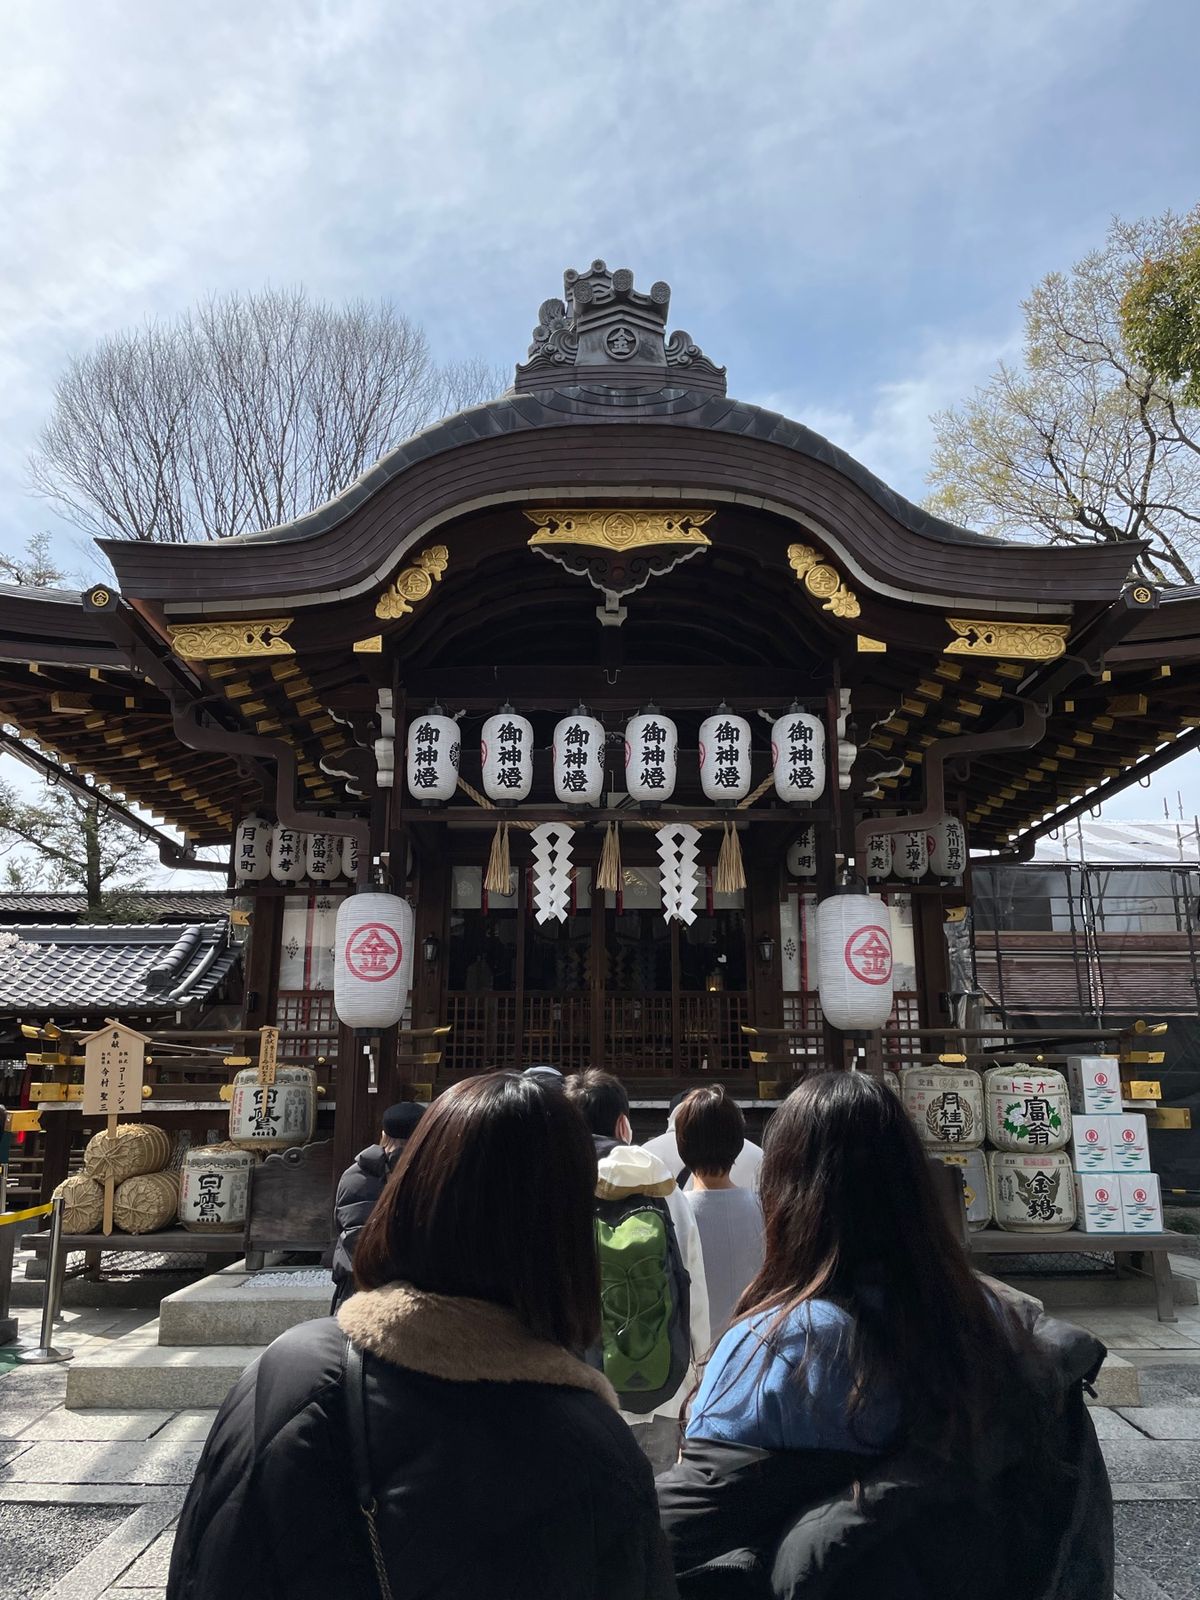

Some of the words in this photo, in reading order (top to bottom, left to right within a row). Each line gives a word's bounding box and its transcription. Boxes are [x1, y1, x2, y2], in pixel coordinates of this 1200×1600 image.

[607, 327, 635, 354] 金
[607, 514, 633, 539] 金
[413, 721, 441, 789] 御神燈
[496, 721, 524, 790] 御神燈
[562, 723, 591, 793] 御神燈
[640, 720, 667, 789] 御神燈
[713, 720, 741, 789] 御神燈
[787, 720, 816, 789] 御神燈
[240, 826, 257, 873] 月見町
[350, 928, 397, 973] 金
[852, 931, 892, 976] 金
[1011, 1082, 1056, 1093] トミオー
[939, 1091, 963, 1143] 月桂冠
[1021, 1095, 1054, 1145] 富翁
[193, 1170, 226, 1223] 白鷹
